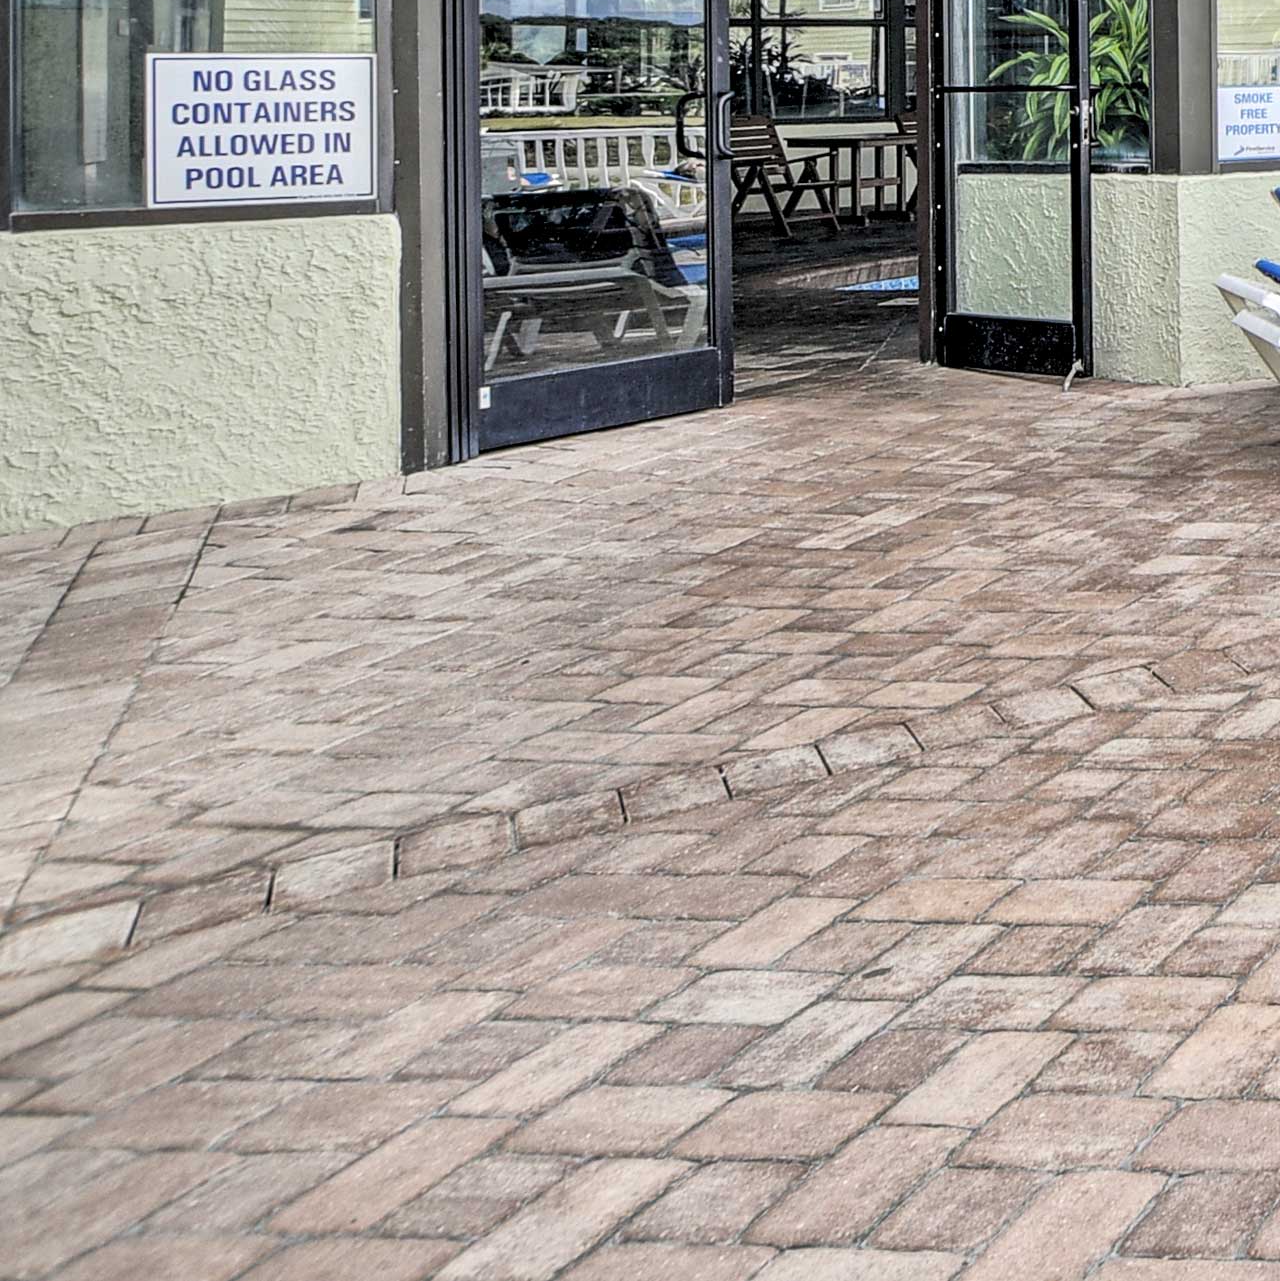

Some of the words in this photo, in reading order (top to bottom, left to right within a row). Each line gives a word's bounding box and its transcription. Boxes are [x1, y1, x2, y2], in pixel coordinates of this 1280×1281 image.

[193, 70, 233, 92] NO
[243, 69, 336, 92] GLASS
[1233, 92, 1273, 104] SMOKE
[171, 100, 356, 125] CONTAINERS
[1240, 108, 1268, 120] FREE
[176, 132, 315, 157] ALLOWED
[324, 132, 351, 153] IN
[185, 167, 261, 190] POOL
[270, 164, 344, 187] AREA
